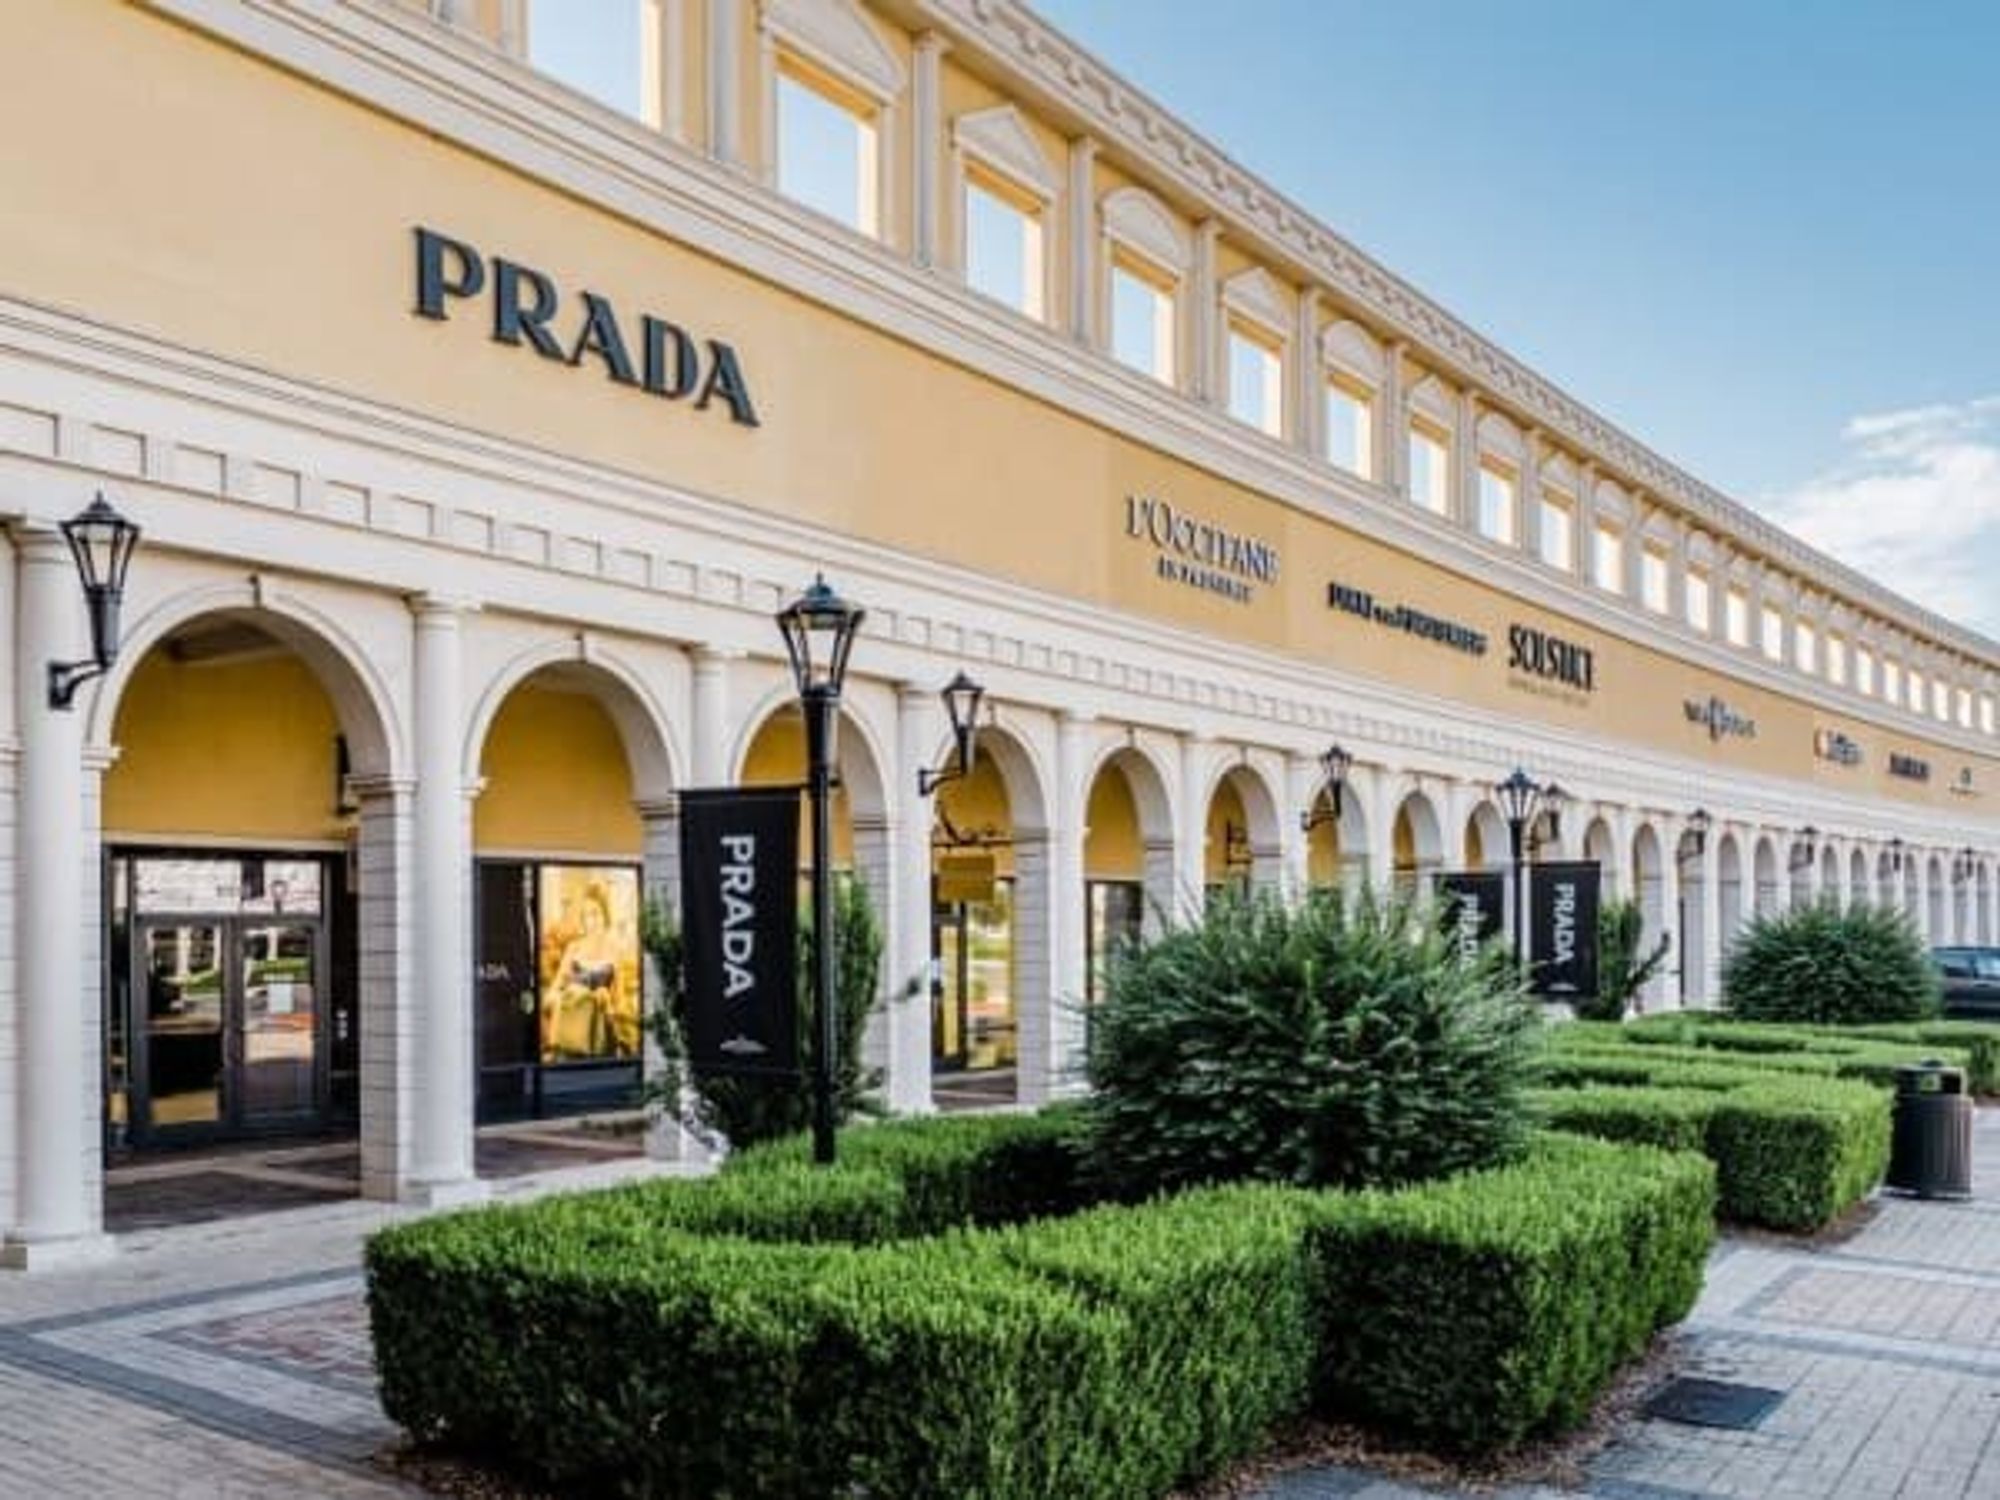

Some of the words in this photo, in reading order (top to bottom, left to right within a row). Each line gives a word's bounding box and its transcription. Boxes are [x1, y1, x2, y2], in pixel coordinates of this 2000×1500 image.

[413, 226, 760, 428] PRADA
[720, 836, 754, 998] PRADA
[1554, 883, 1575, 964] PRADA
